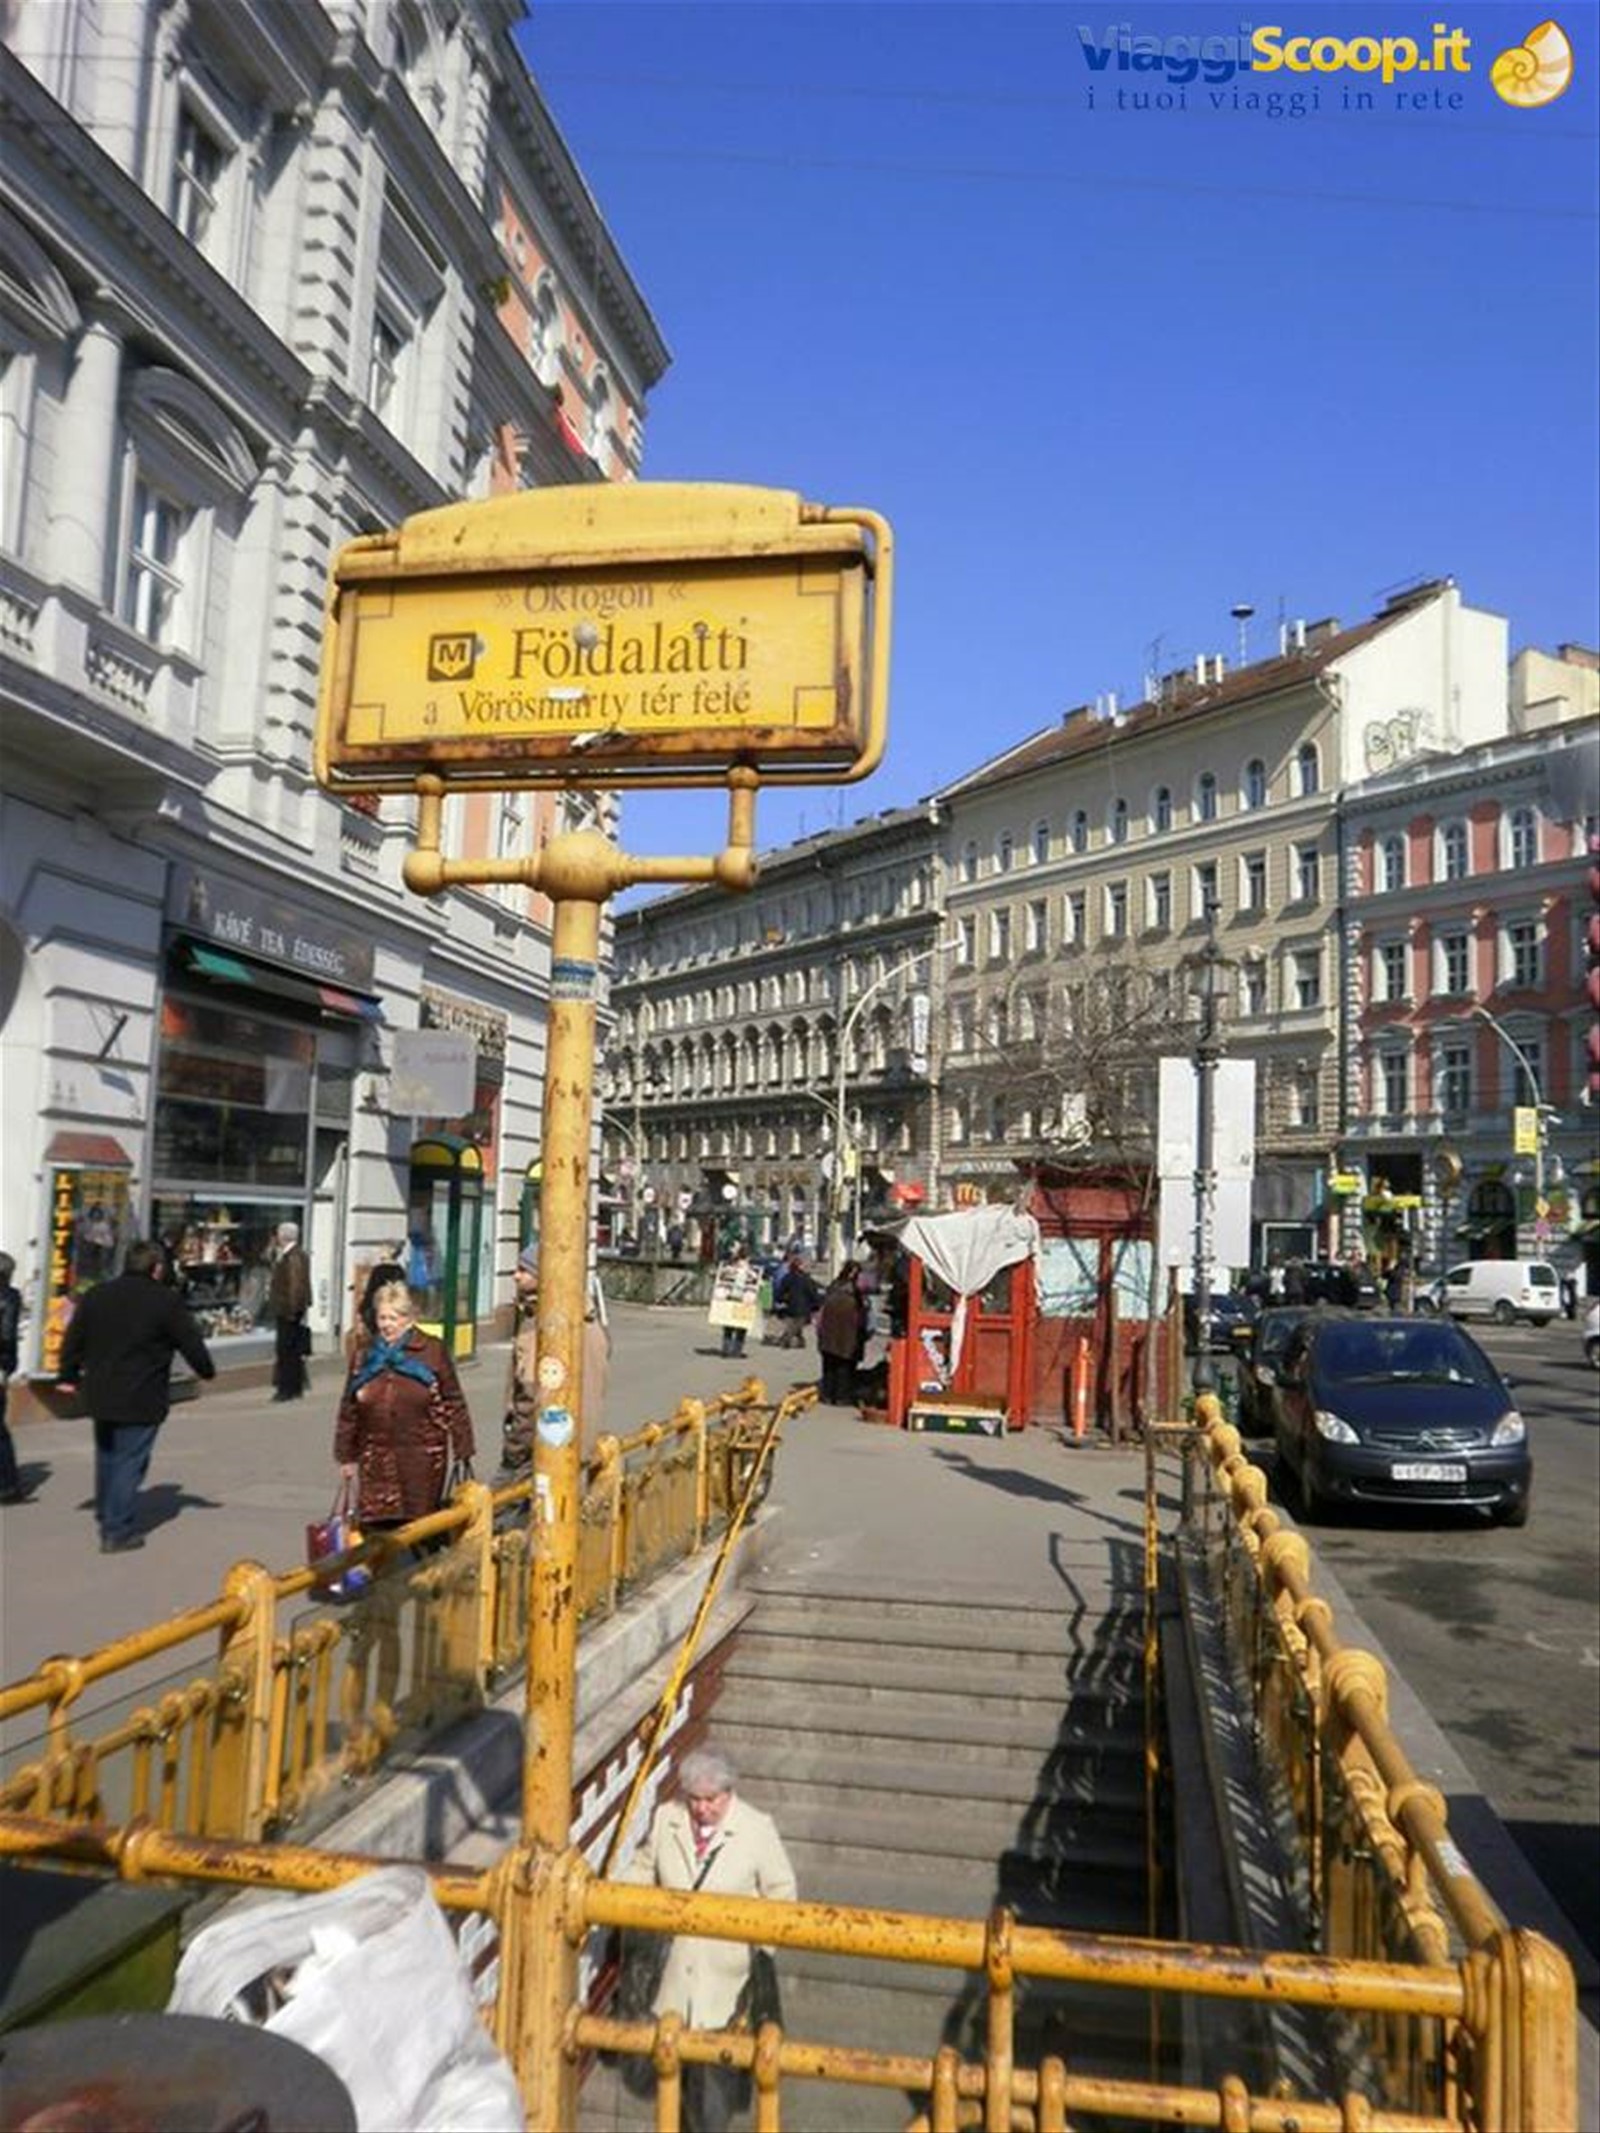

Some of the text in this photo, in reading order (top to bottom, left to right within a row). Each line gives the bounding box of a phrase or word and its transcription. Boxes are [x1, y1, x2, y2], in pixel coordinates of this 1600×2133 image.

[524, 582, 653, 619] Oktogon
[508, 616, 748, 680] Földalatti
[423, 680, 751, 729] a Vörösmarty tér felé
